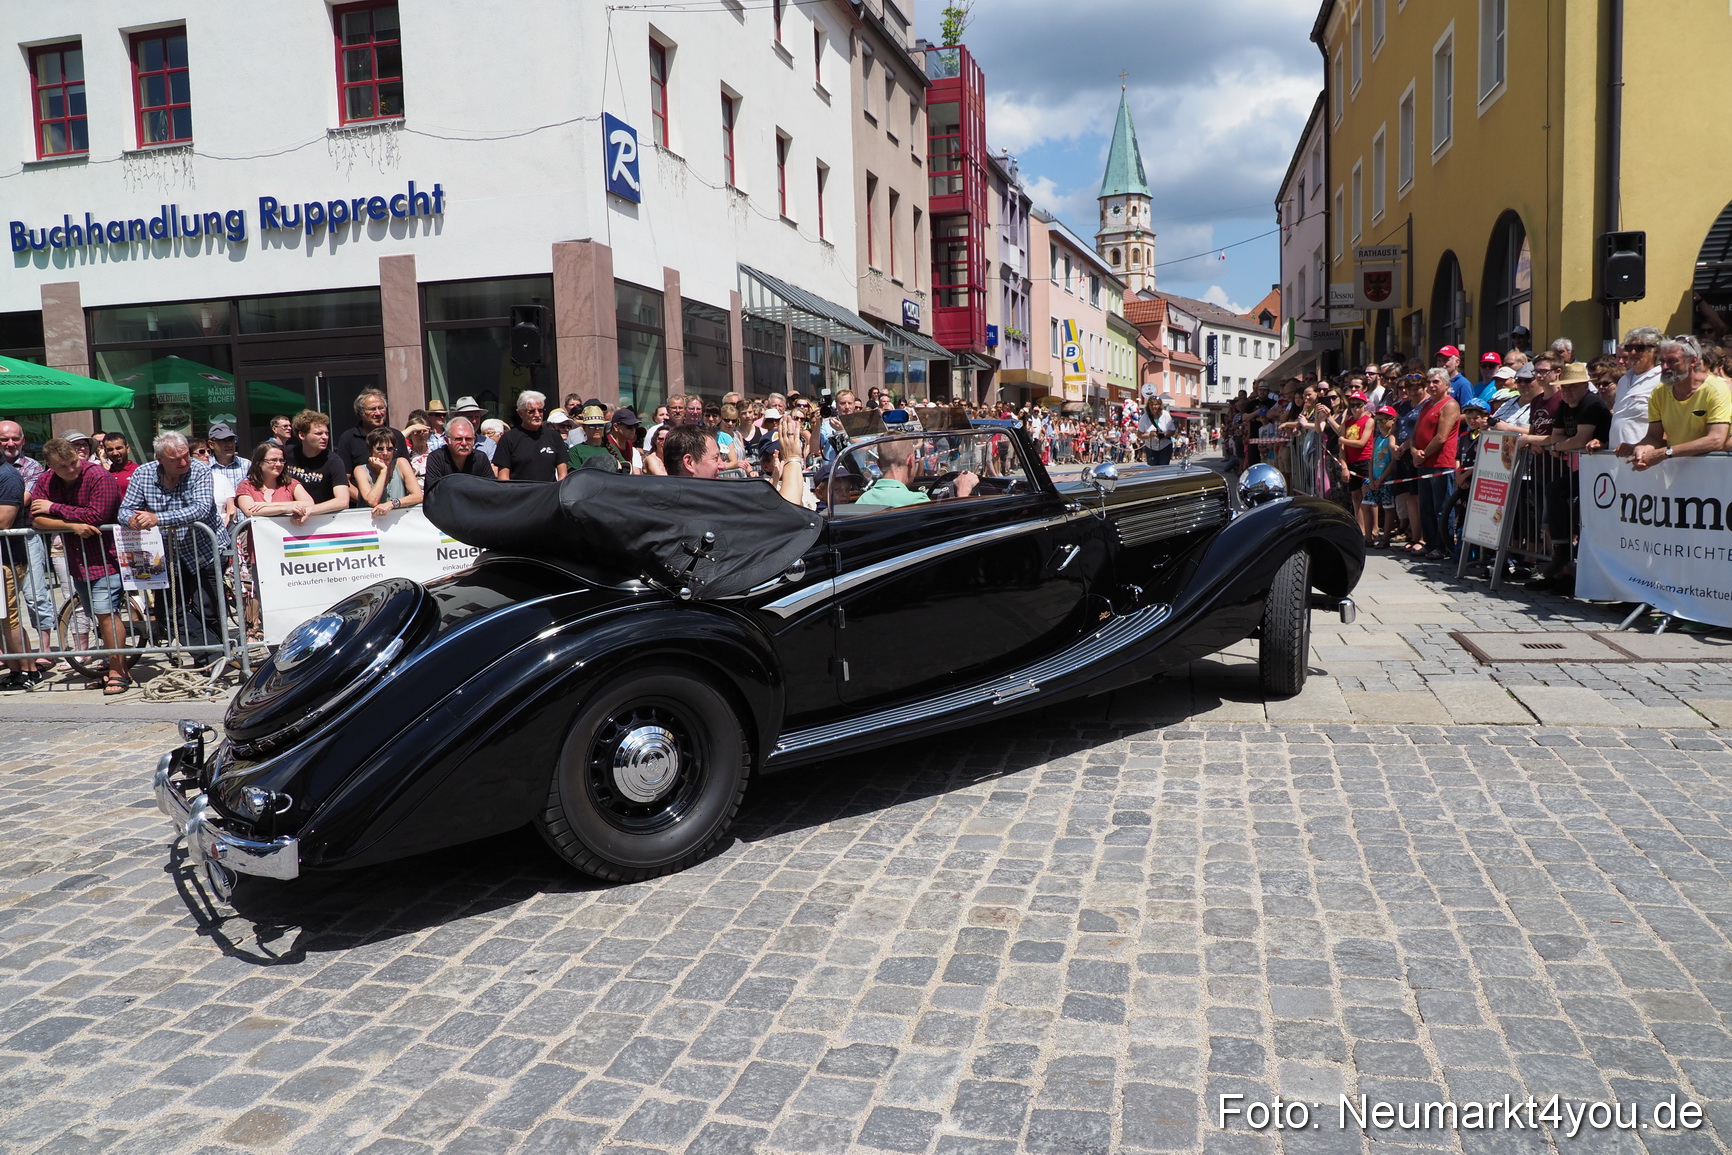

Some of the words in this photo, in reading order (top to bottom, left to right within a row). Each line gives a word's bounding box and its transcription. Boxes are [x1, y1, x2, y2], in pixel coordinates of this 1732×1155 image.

[609, 129, 640, 192] R
[9, 204, 247, 252] Buchhandlung
[259, 180, 445, 236] Rupprecht
[1358, 249, 1392, 258] RATHAUS
[1330, 290, 1354, 300] Dessou
[1065, 346, 1076, 357] B
[207, 385, 235, 396] MÄNNE
[158, 393, 187, 402] OLDTIMER
[1620, 537, 1640, 551] DAS
[279, 553, 386, 576] NeuerMarkt
[287, 577, 323, 588] einkaufen
[327, 575, 348, 583] leben
[351, 571, 384, 582] genießen
